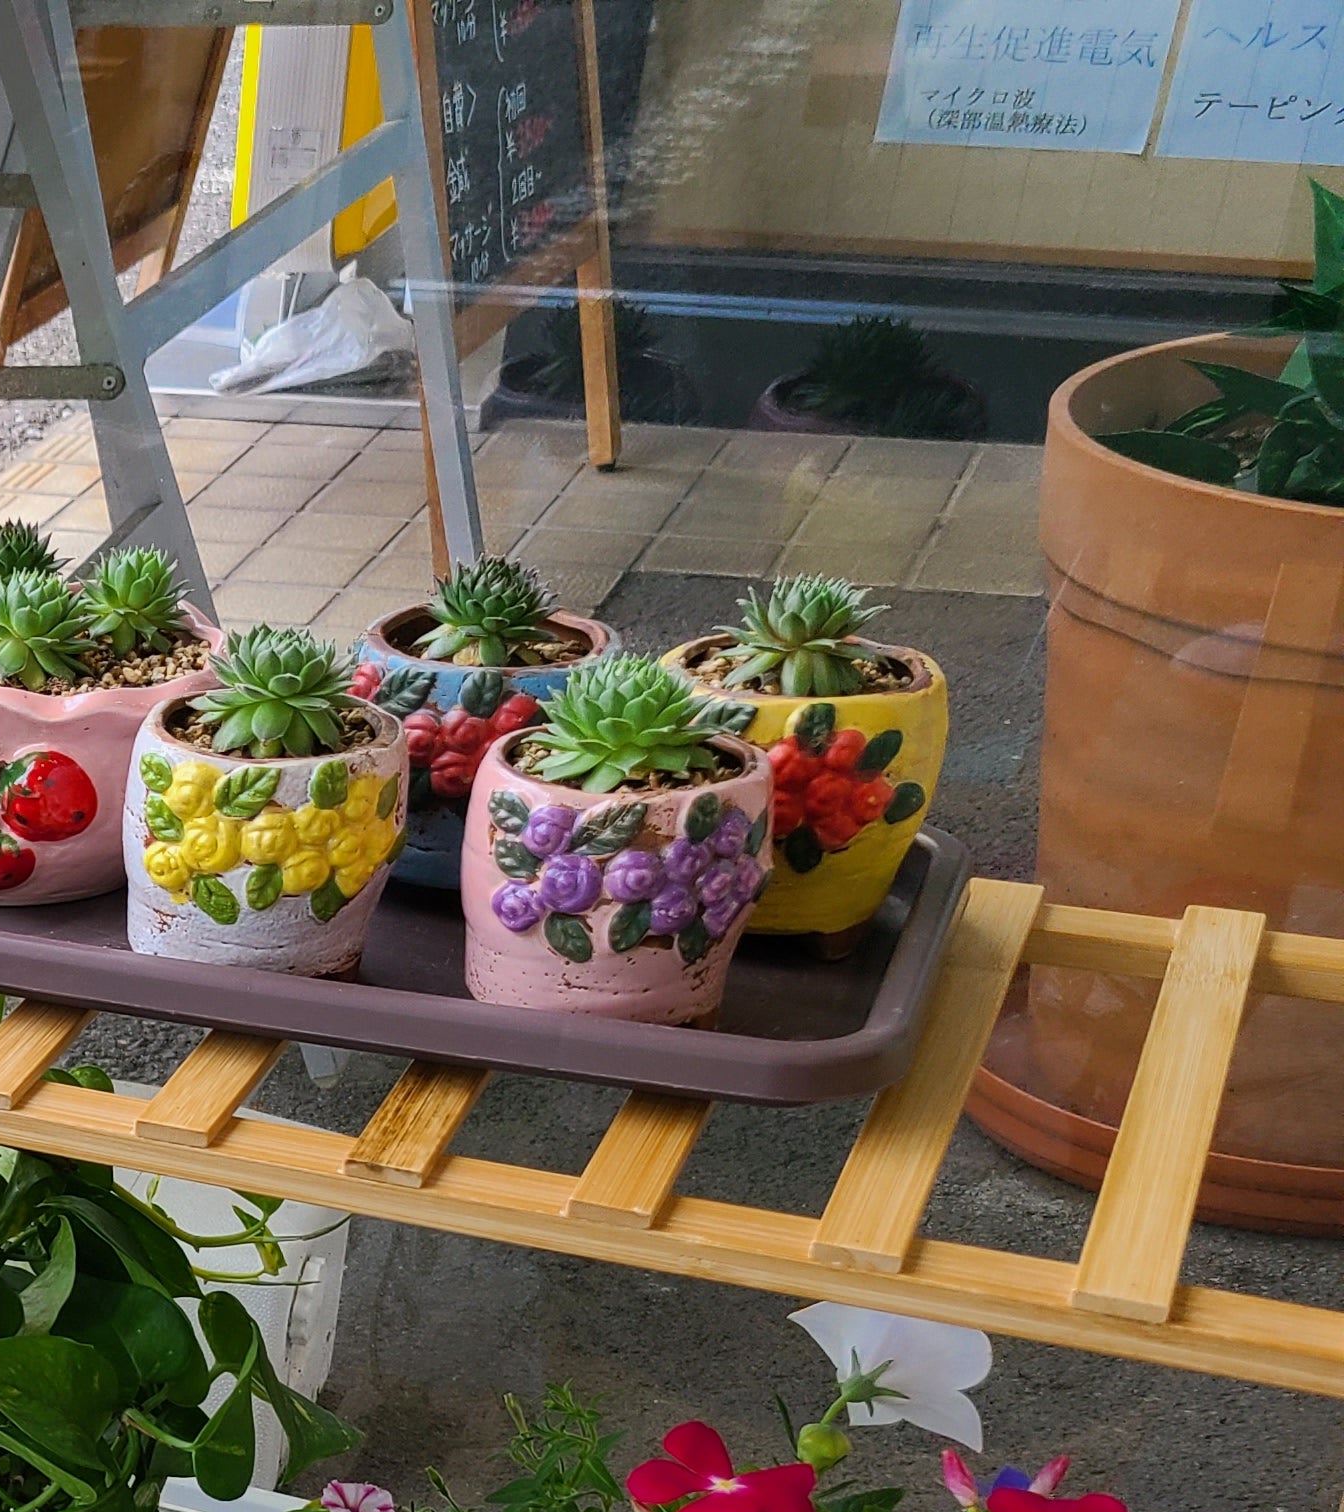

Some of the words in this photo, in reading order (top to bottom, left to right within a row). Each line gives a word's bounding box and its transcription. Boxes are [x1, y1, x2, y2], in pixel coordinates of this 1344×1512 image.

[911, 22, 1159, 69] 再生促進電気
[1201, 21, 1328, 51] ヘルス
[920, 85, 1036, 110] マイクロ波
